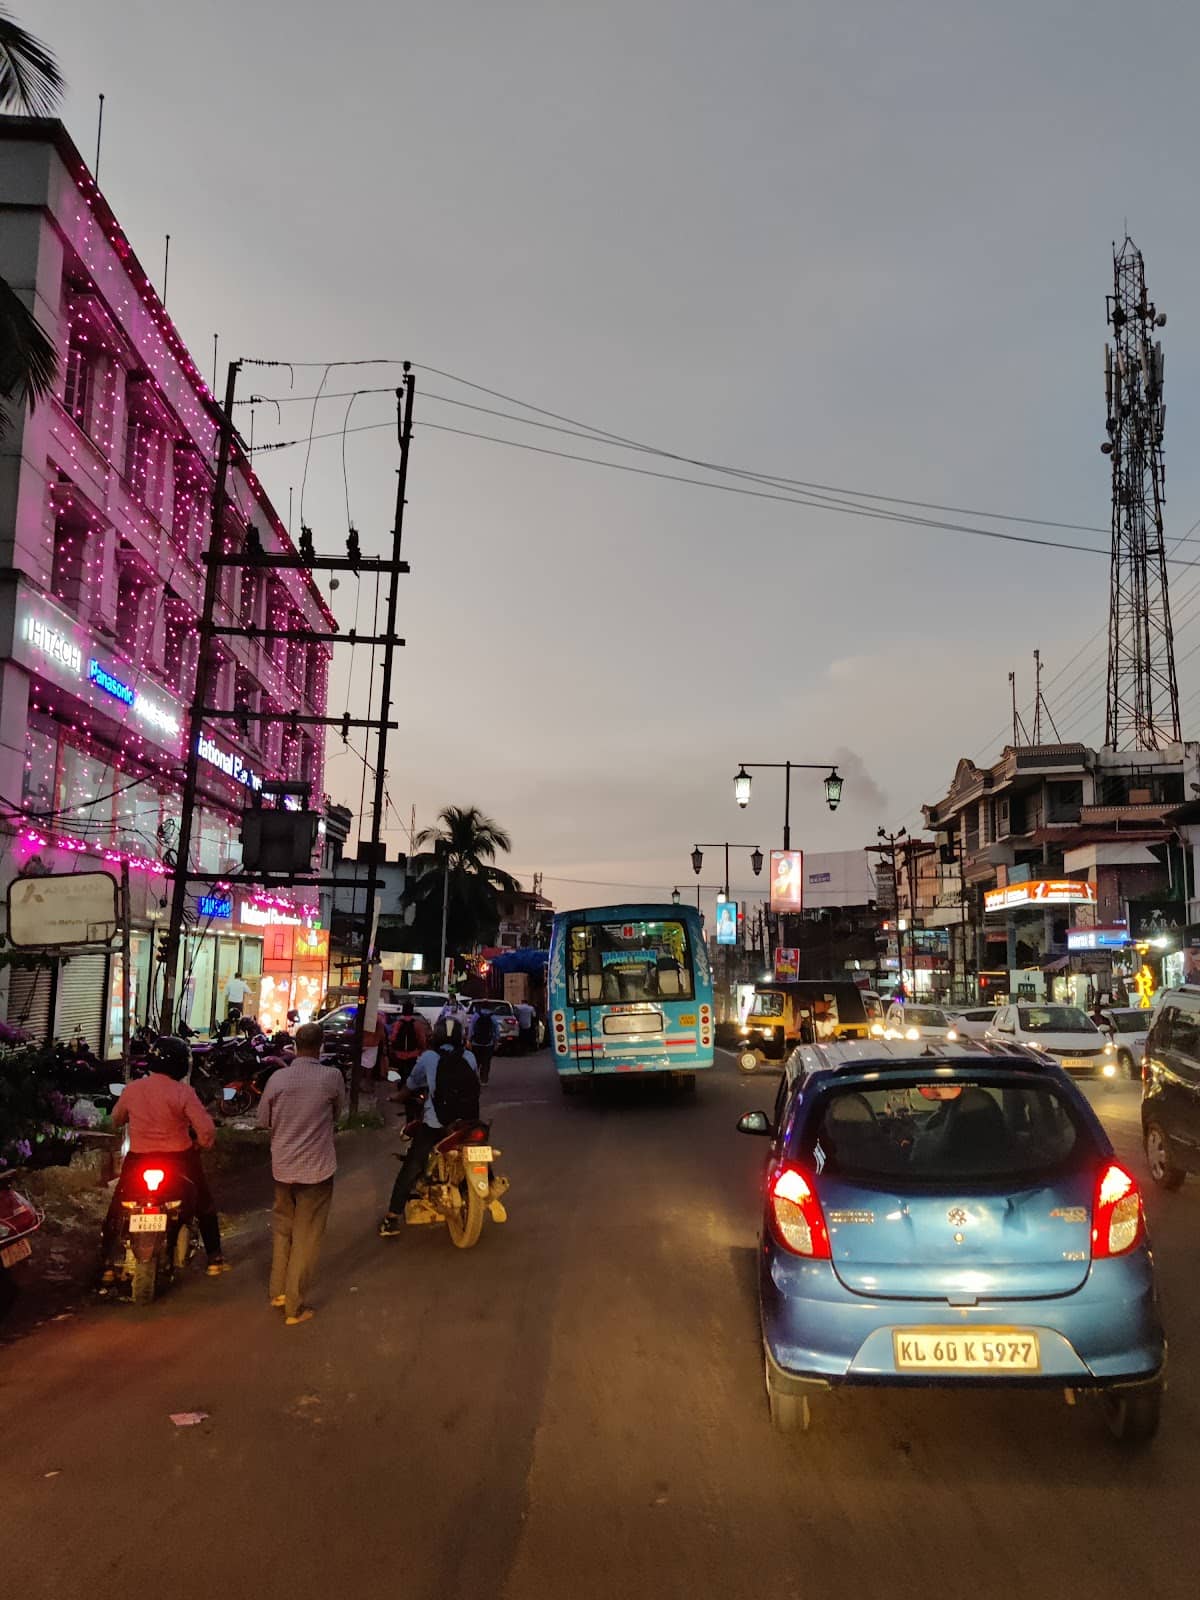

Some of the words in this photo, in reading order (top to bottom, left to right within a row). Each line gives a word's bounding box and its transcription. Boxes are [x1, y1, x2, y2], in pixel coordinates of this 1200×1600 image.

[90, 659, 134, 705] Panasonic
[901, 1341, 926, 1361] KL
[934, 1341, 957, 1361] 60
[964, 1341, 976, 1361] K
[982, 1342, 1032, 1362] 5977
